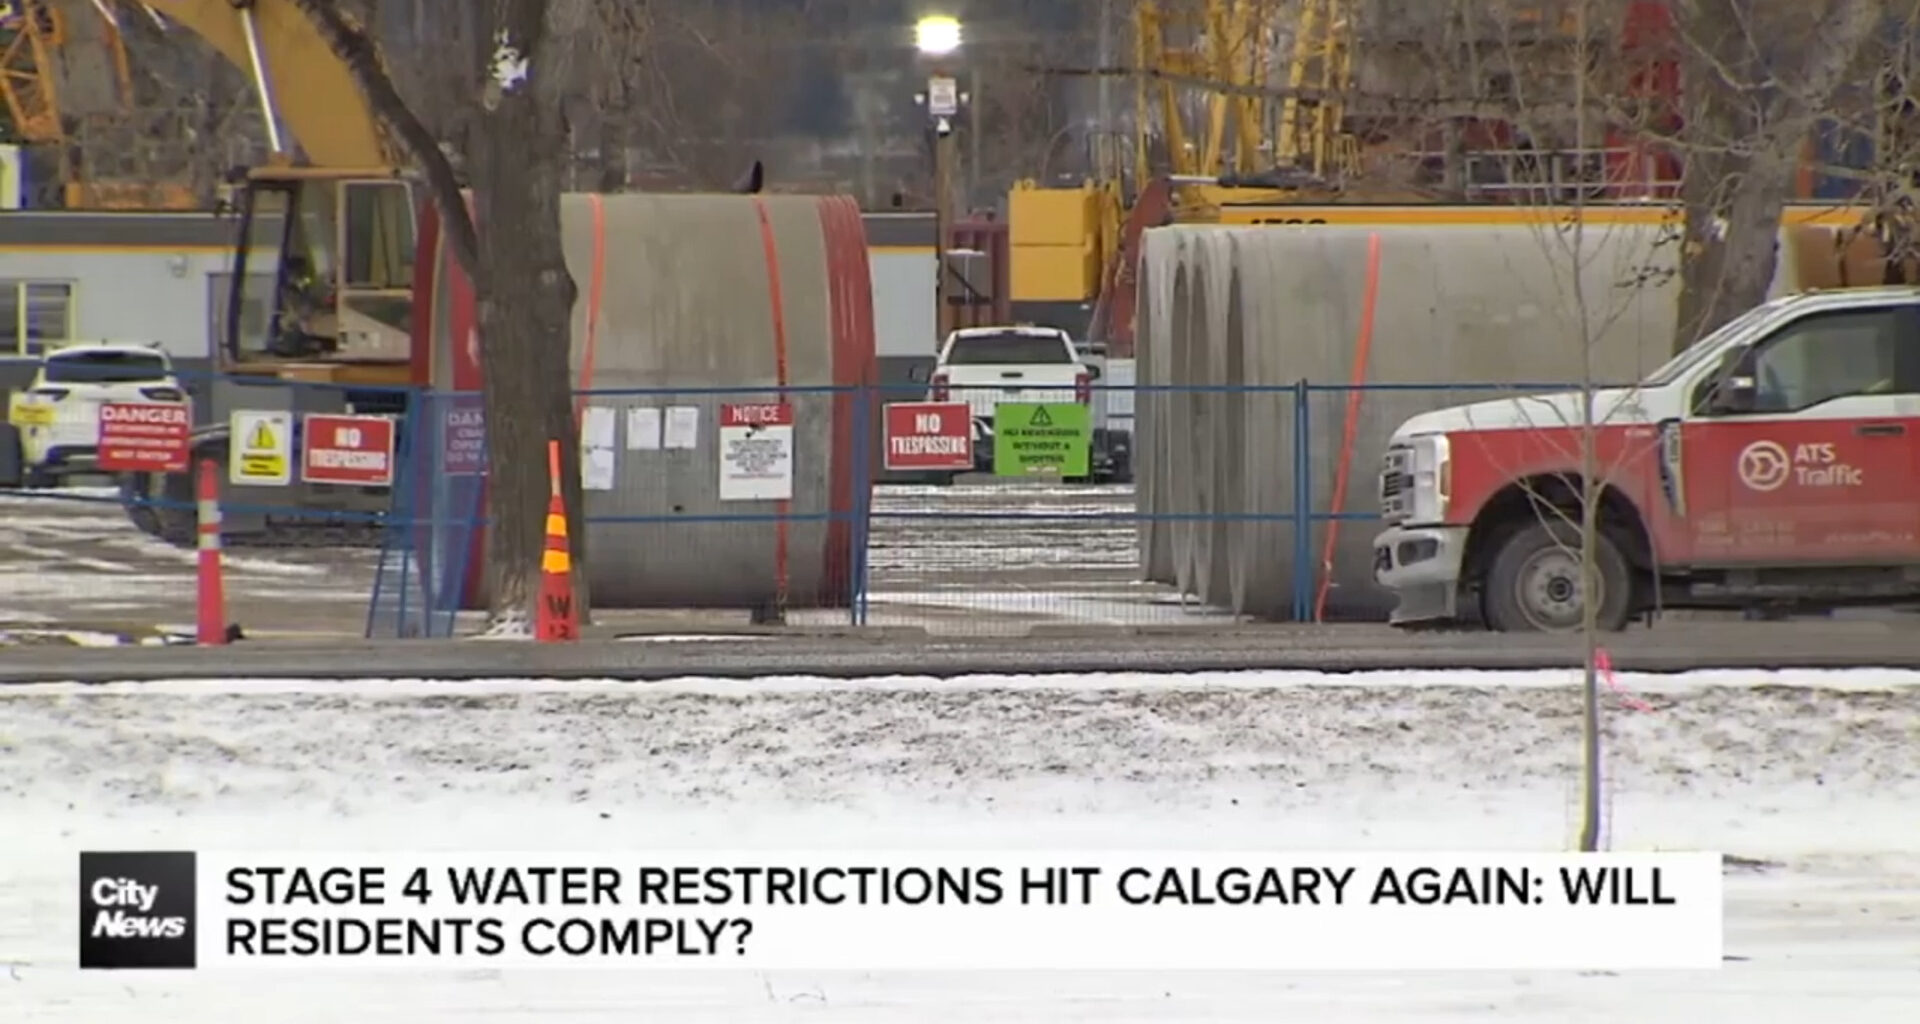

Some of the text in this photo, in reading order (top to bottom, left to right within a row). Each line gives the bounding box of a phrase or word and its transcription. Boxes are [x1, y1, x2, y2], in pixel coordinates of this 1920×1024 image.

[101, 406, 187, 422] DANGER
[732, 406, 779, 422] NOTICE
[915, 414, 942, 432] NO
[1795, 443, 1836, 462] ATS
[1795, 464, 1863, 486] Traffic
